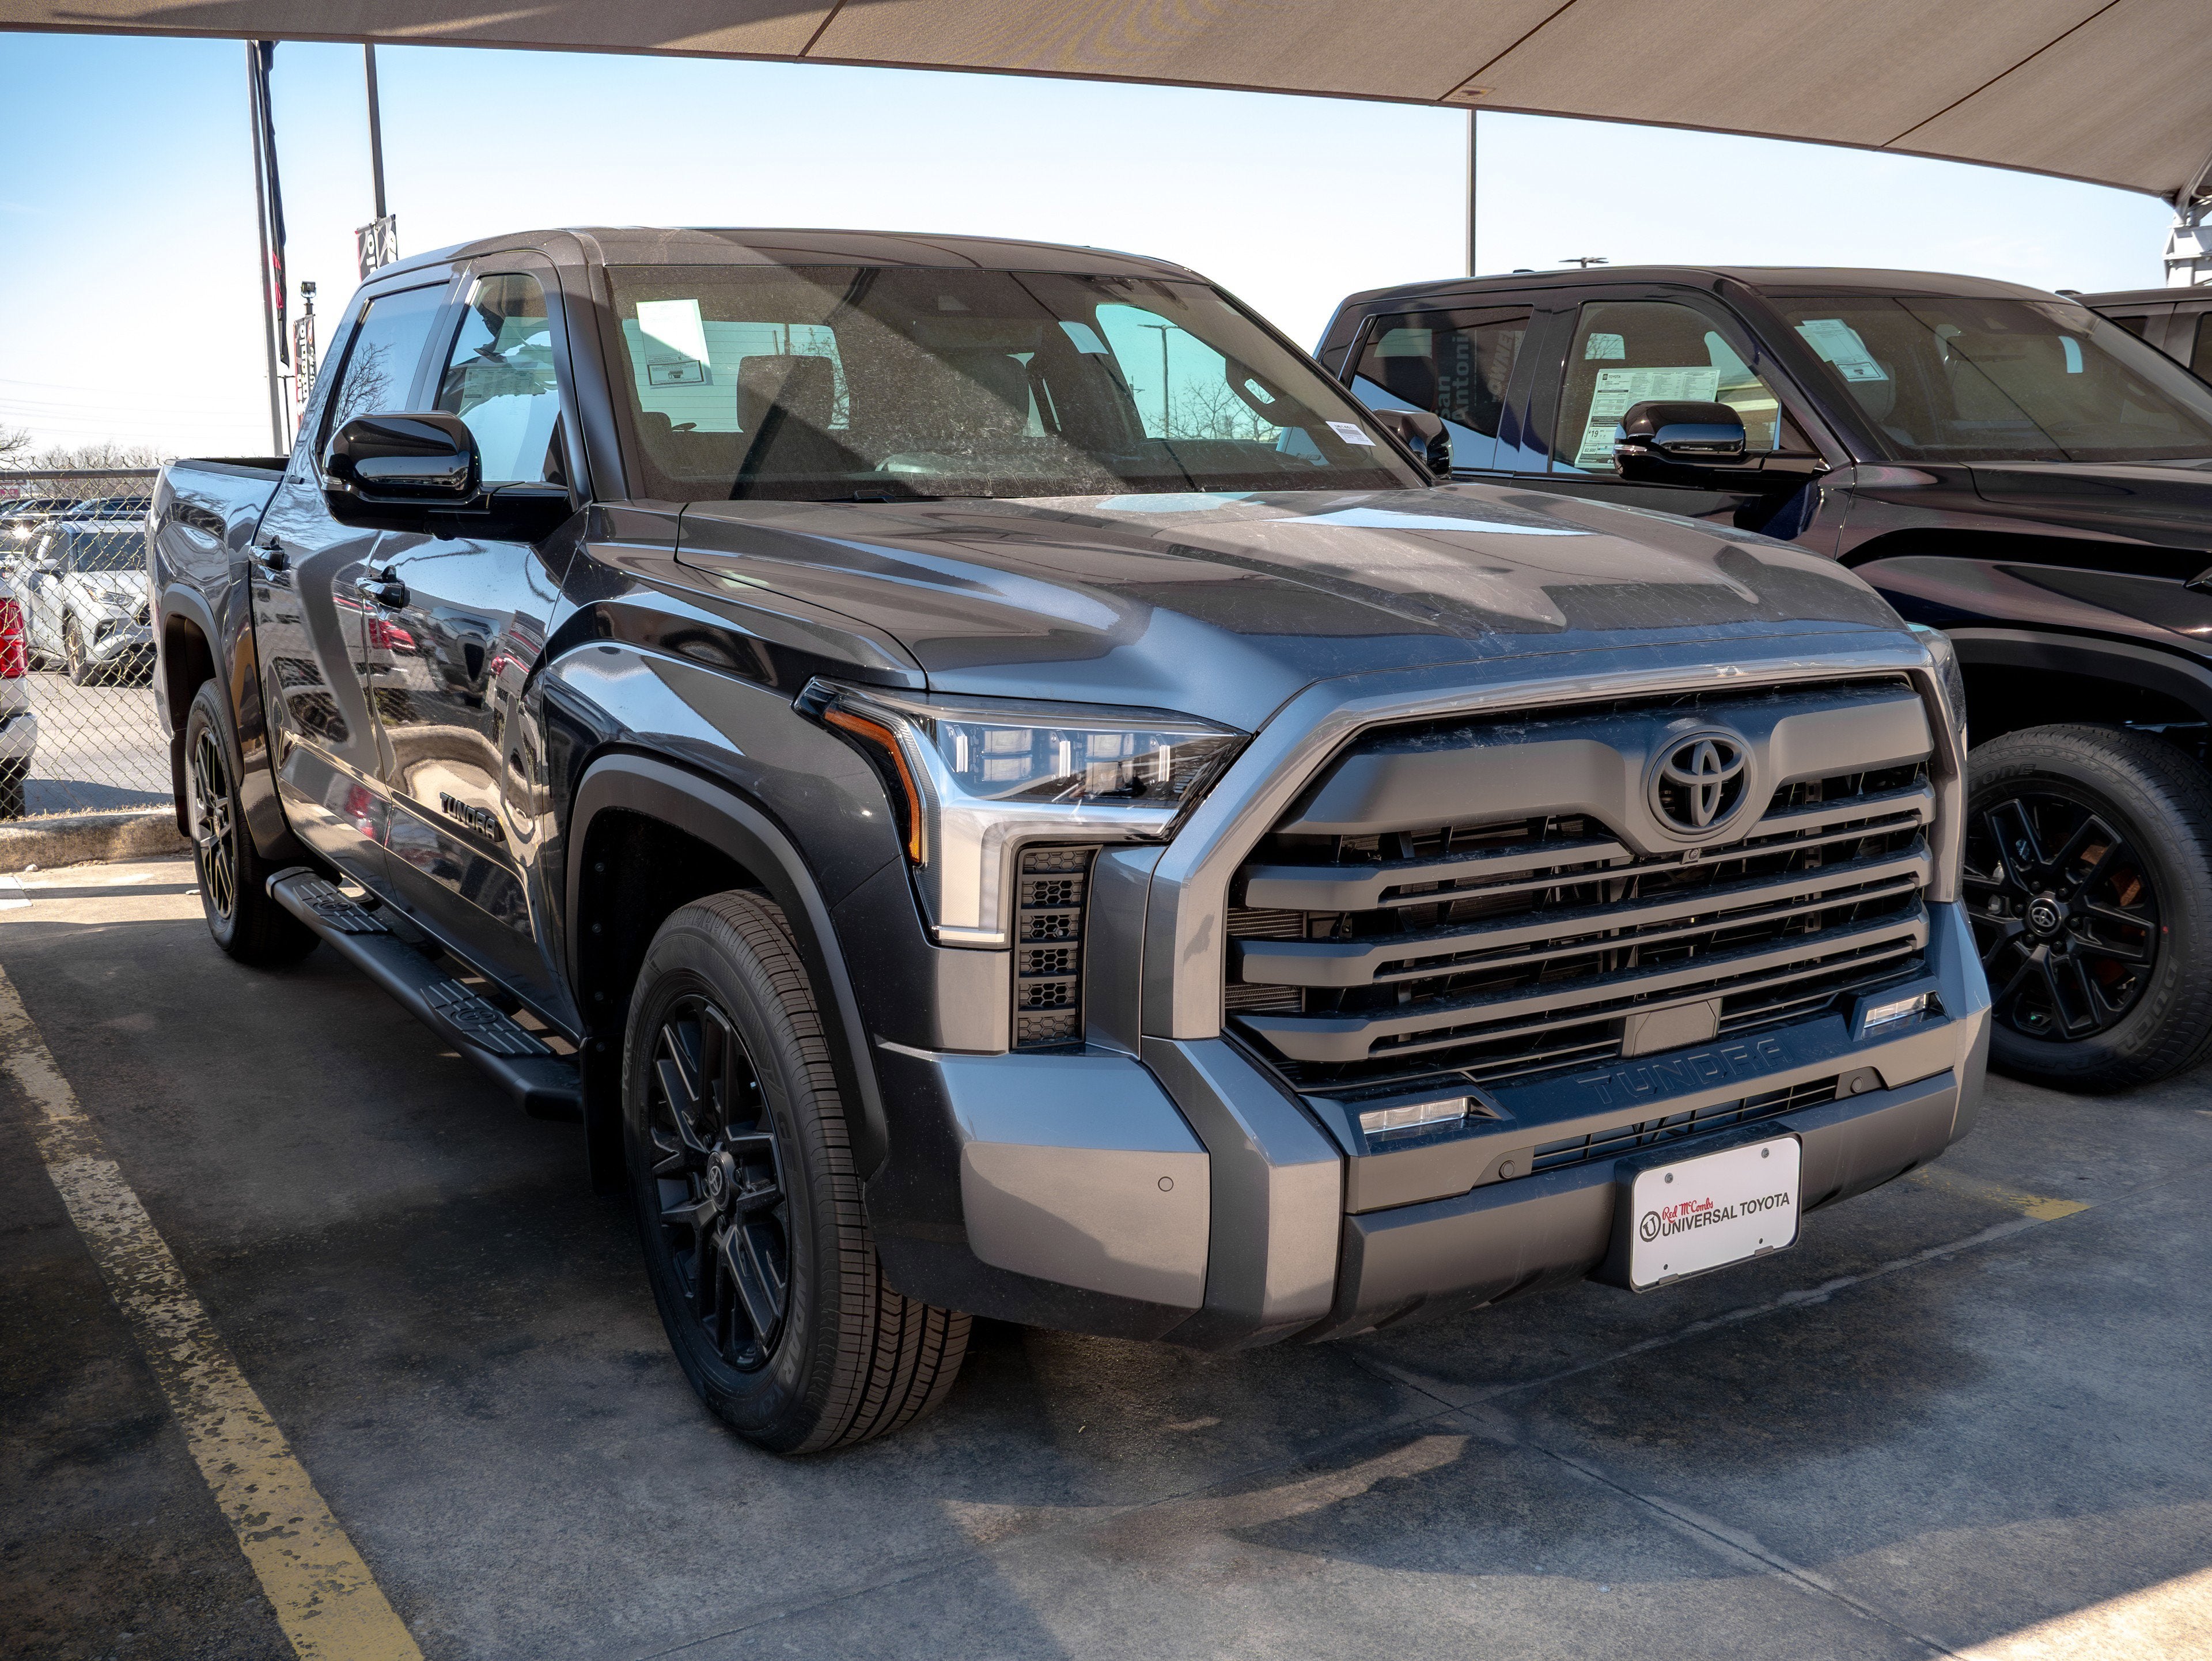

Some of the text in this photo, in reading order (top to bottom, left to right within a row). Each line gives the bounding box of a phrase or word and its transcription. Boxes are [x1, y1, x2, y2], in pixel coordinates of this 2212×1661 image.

[440, 792, 500, 842] TUNDRA
[1574, 1038, 1794, 1104] TUNDRA
[1662, 1197, 1713, 1223] Red McCombs
[1662, 1192, 1790, 1236] UNIVERSAL TOYOTA
